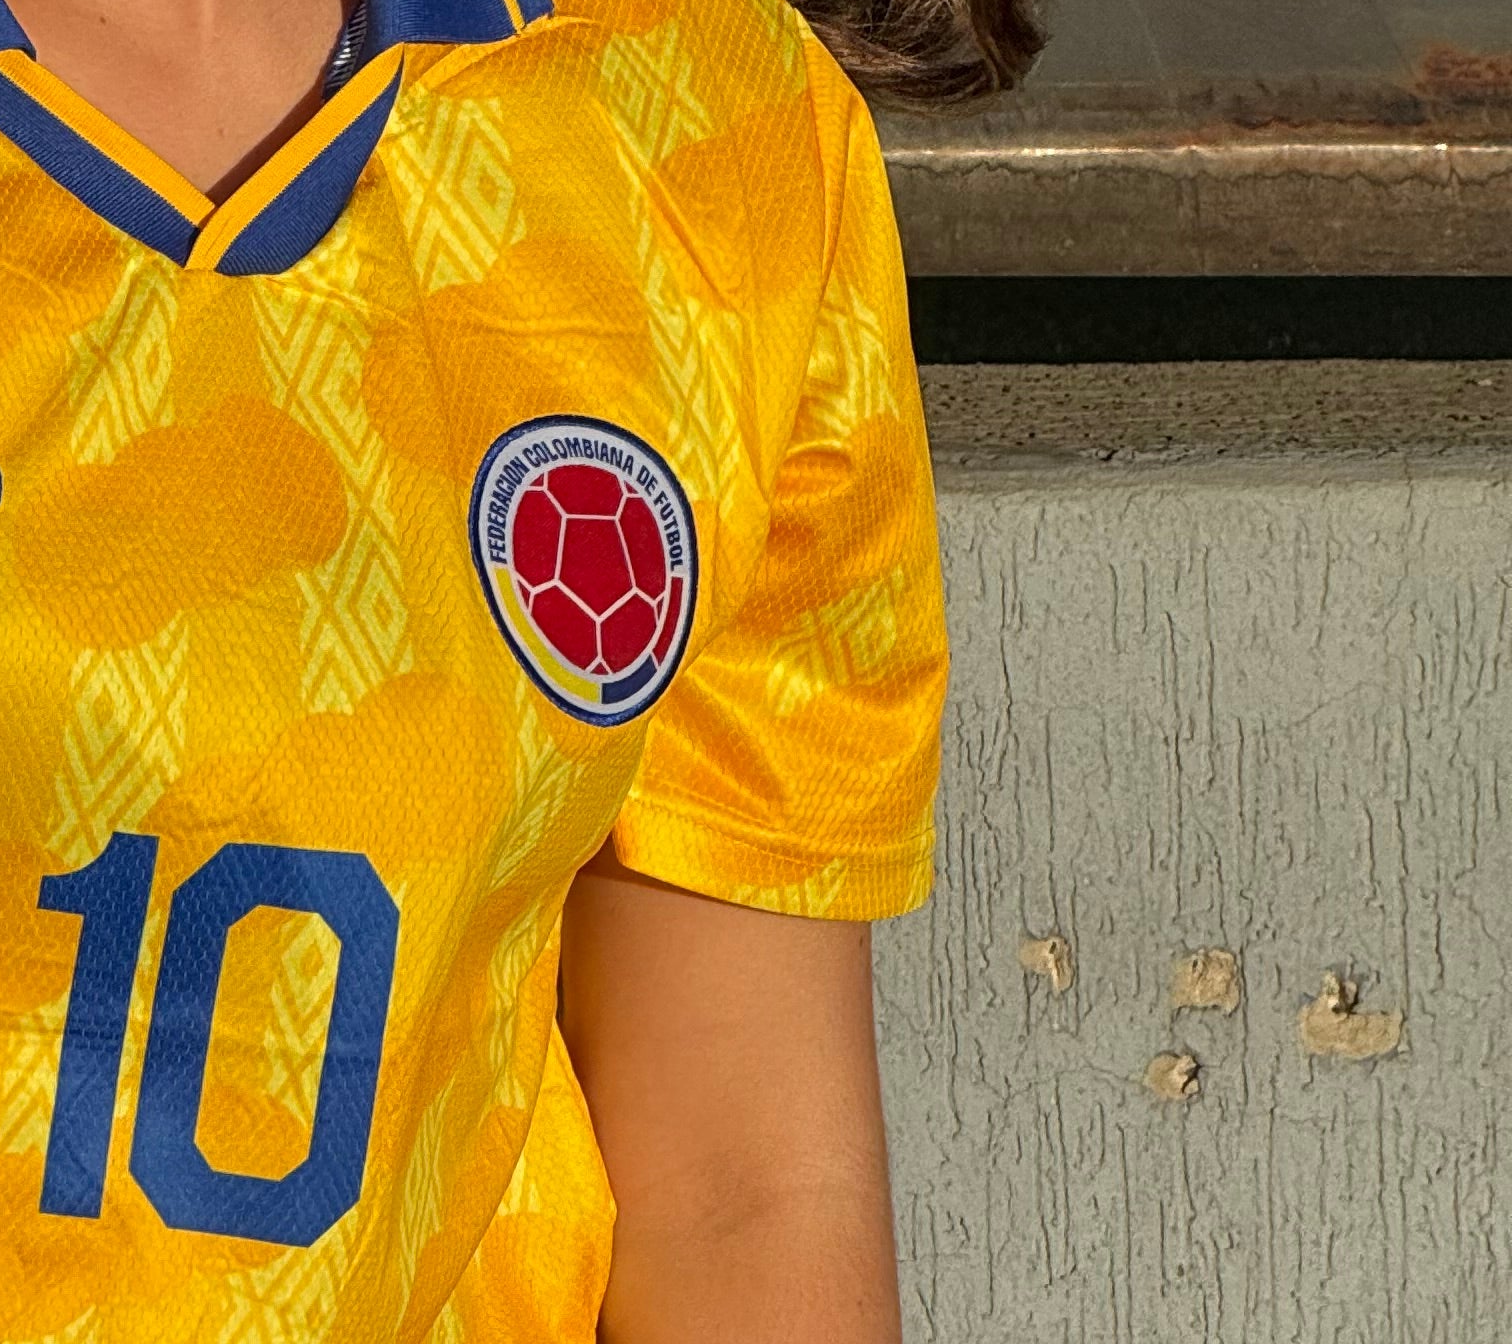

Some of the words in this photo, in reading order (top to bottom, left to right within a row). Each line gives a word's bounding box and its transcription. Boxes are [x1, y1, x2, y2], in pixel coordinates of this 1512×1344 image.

[487, 455, 530, 564] FEDERACION
[522, 437, 634, 476] COLOMBIANA
[635, 465, 658, 497] DE
[653, 490, 684, 572] FUTBOL
[36, 831, 401, 1248] 10
